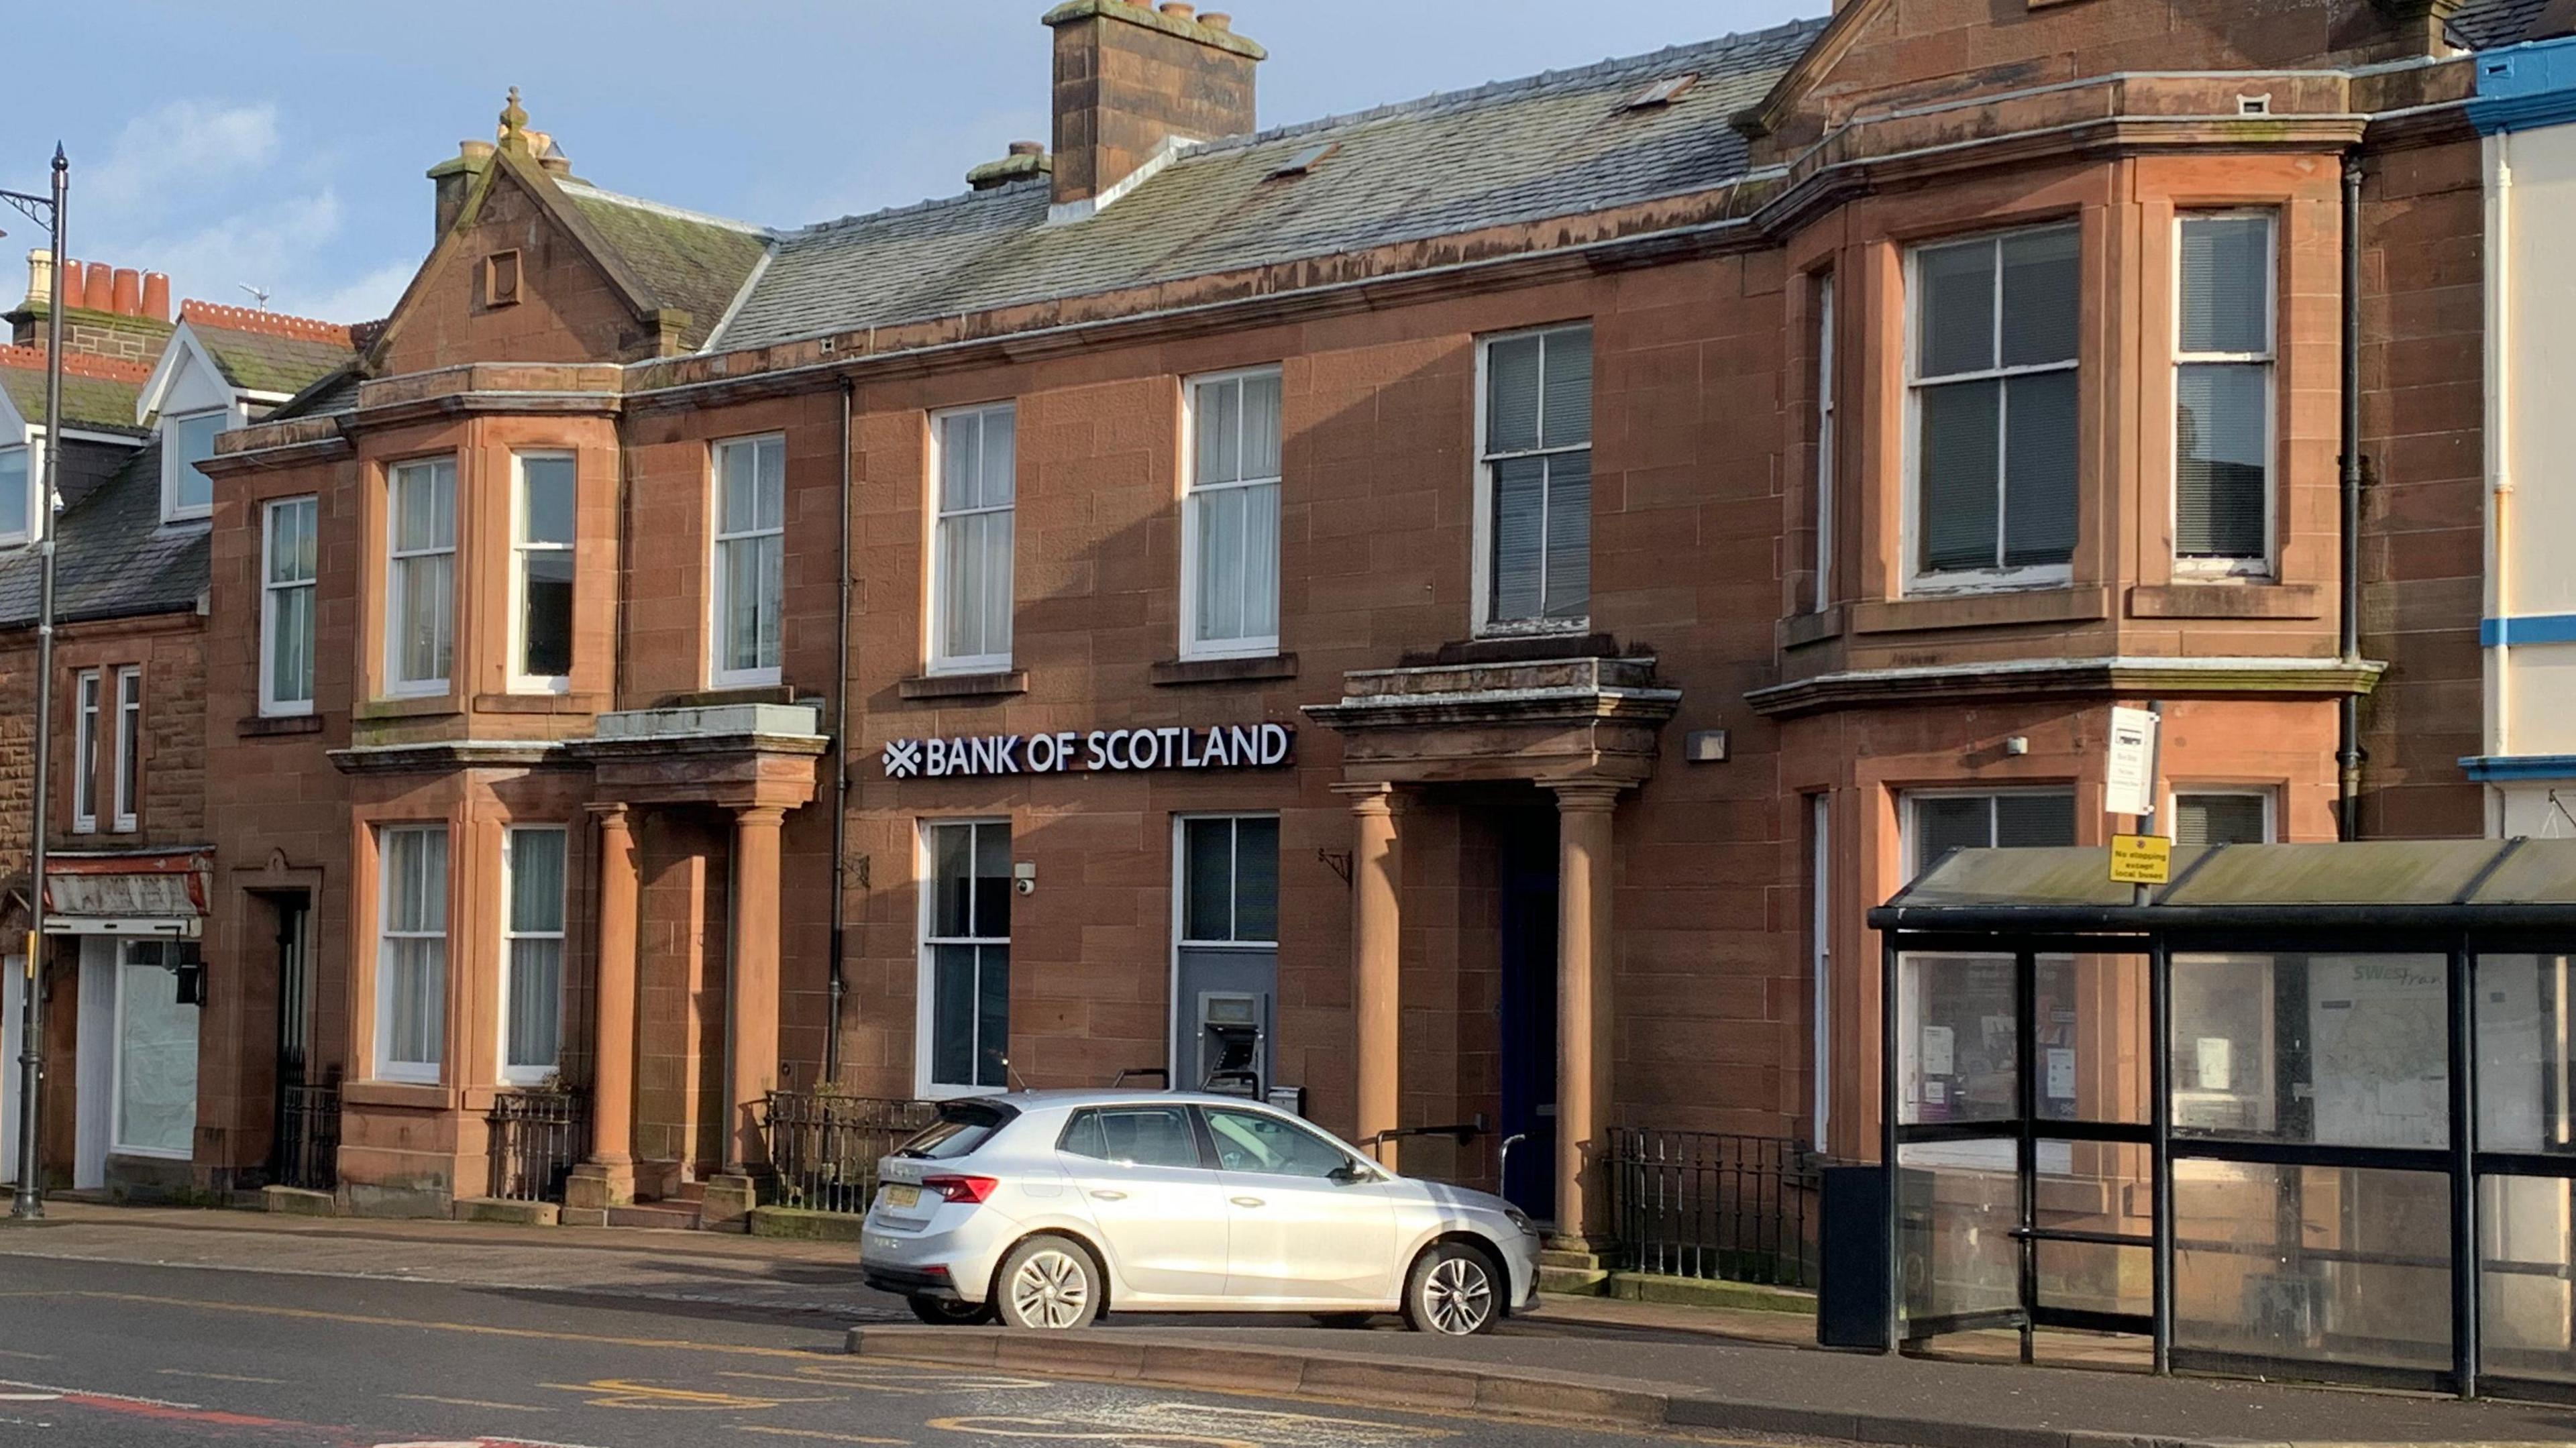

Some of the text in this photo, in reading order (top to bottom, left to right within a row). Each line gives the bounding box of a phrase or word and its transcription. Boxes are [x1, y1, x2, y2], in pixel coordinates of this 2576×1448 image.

[927, 723, 1287, 776] BANK OF SCOTLAND
[2130, 852, 2166, 862] stopping
[2115, 869, 2163, 879] local buses
